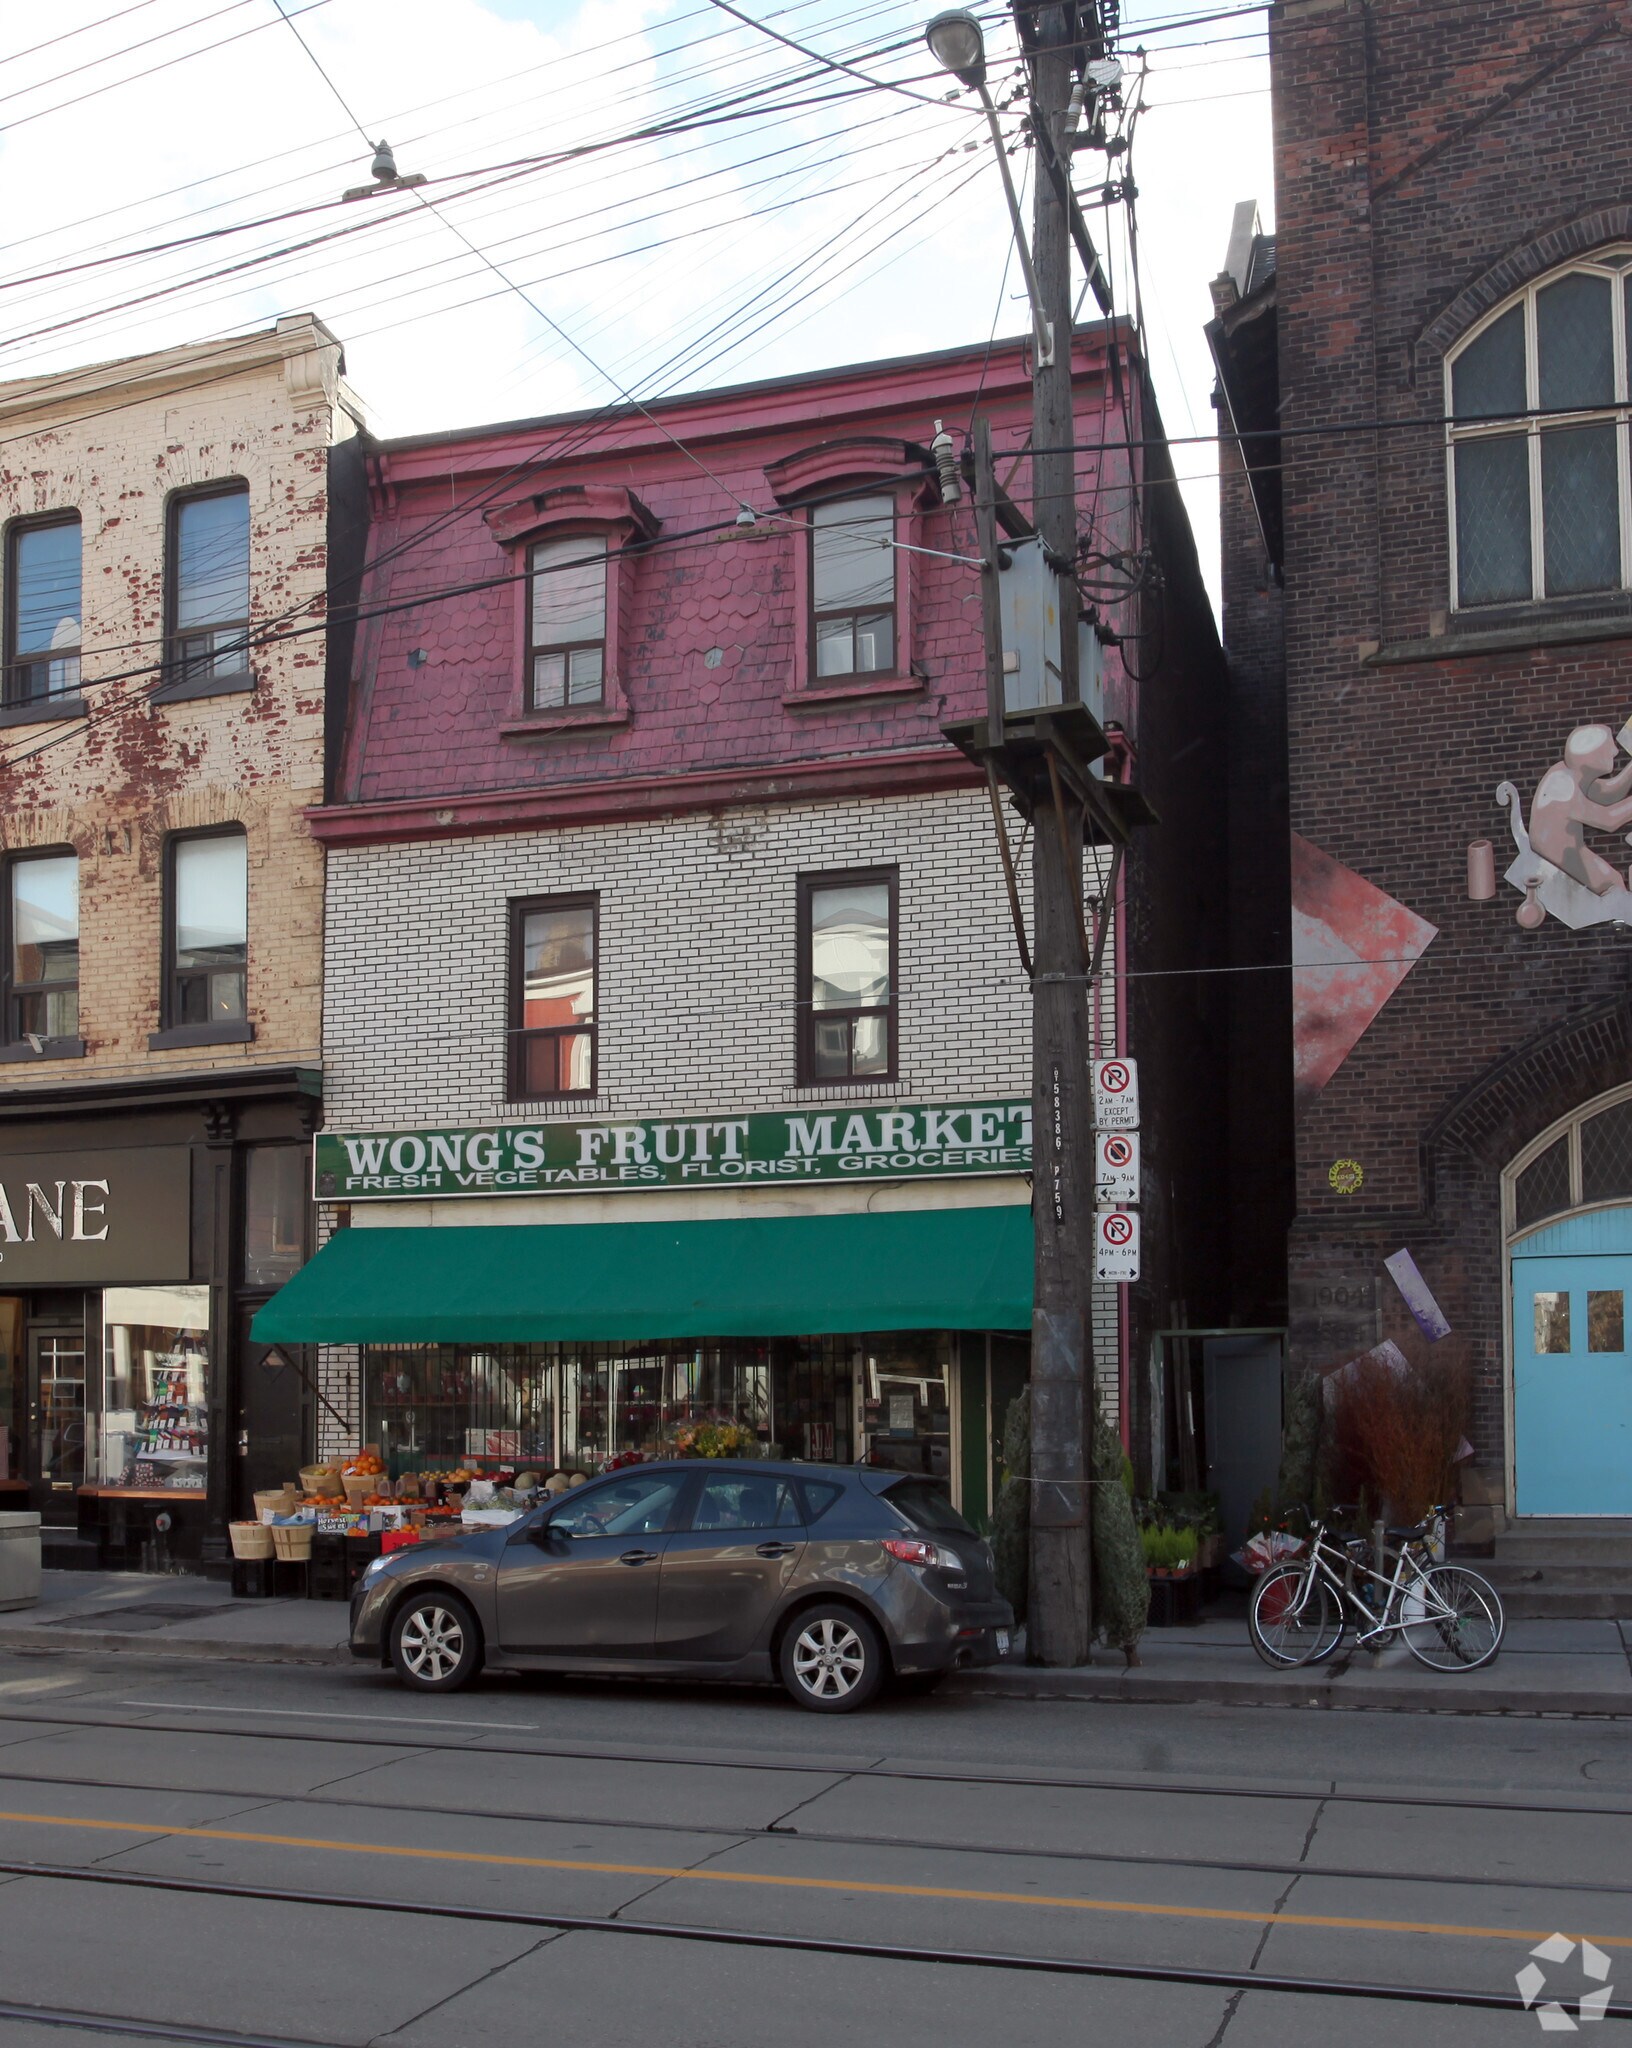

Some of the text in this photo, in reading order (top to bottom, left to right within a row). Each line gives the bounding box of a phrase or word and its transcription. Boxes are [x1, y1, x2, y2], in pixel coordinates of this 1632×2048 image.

[1100, 1116, 1135, 1126] BY PERMIT
[1104, 1107, 1129, 1116] EXCEPT
[344, 1130, 545, 1175] WONG'S
[576, 1120, 749, 1166] FRUIT
[346, 1173, 441, 1190] FRESH
[455, 1165, 666, 1186] VEGETABLES,
[682, 1157, 822, 1178] FLORIST,
[811, 1423, 832, 1449] ATM
